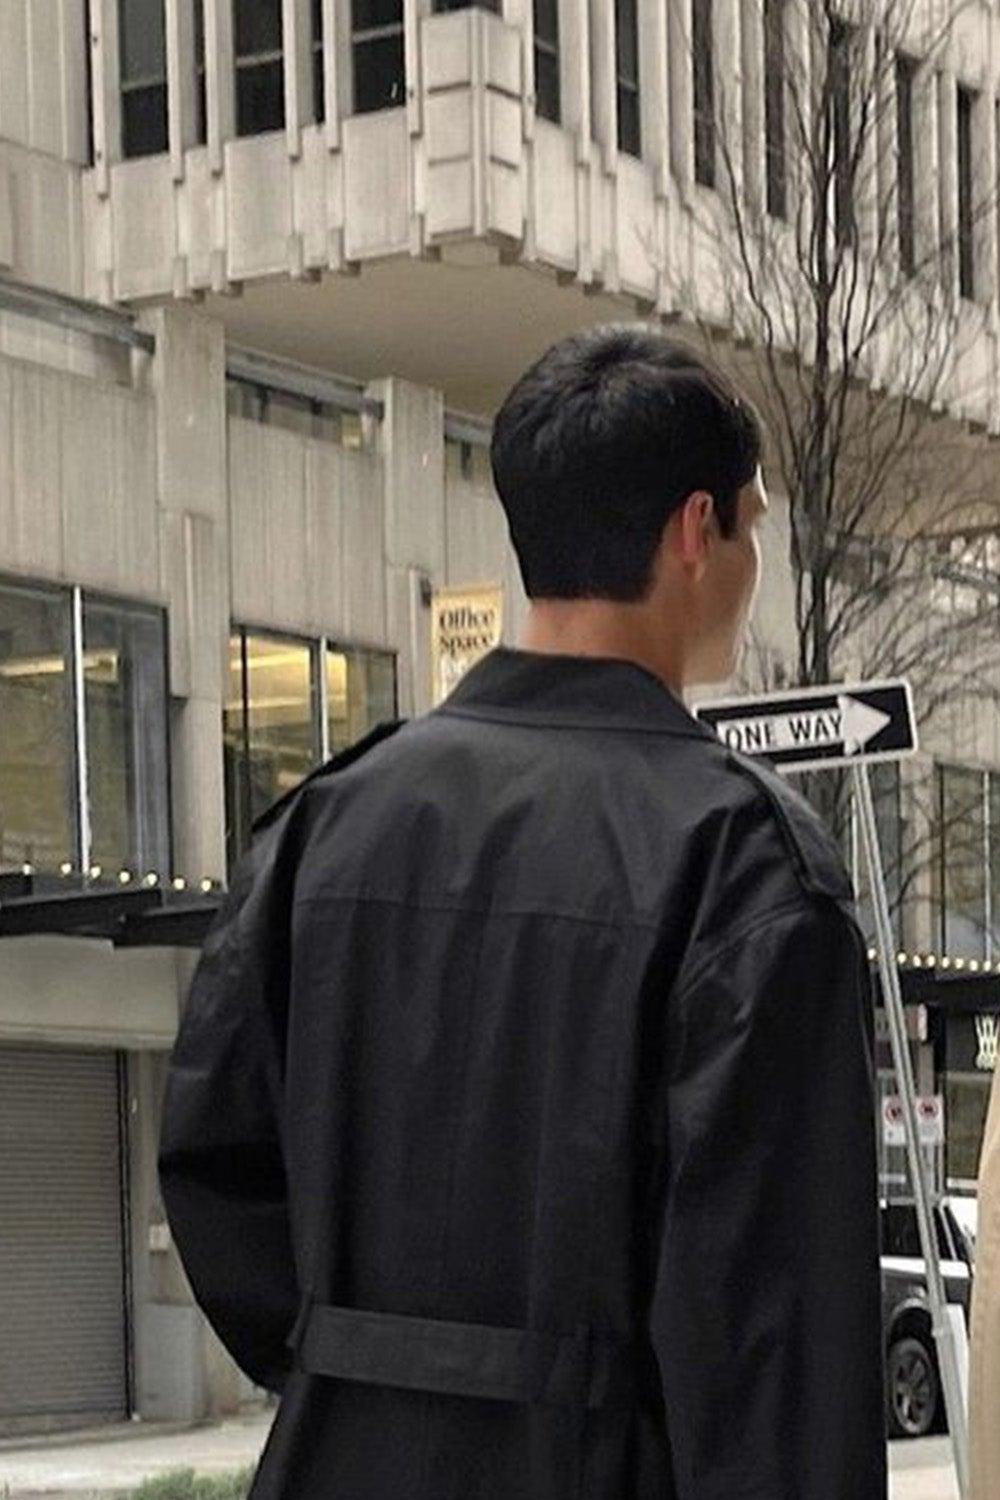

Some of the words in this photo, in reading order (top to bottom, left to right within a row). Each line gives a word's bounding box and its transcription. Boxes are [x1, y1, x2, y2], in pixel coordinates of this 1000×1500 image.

[438, 607, 495, 630] Office
[439, 633, 494, 657] Space
[788, 711, 842, 743] WAY
